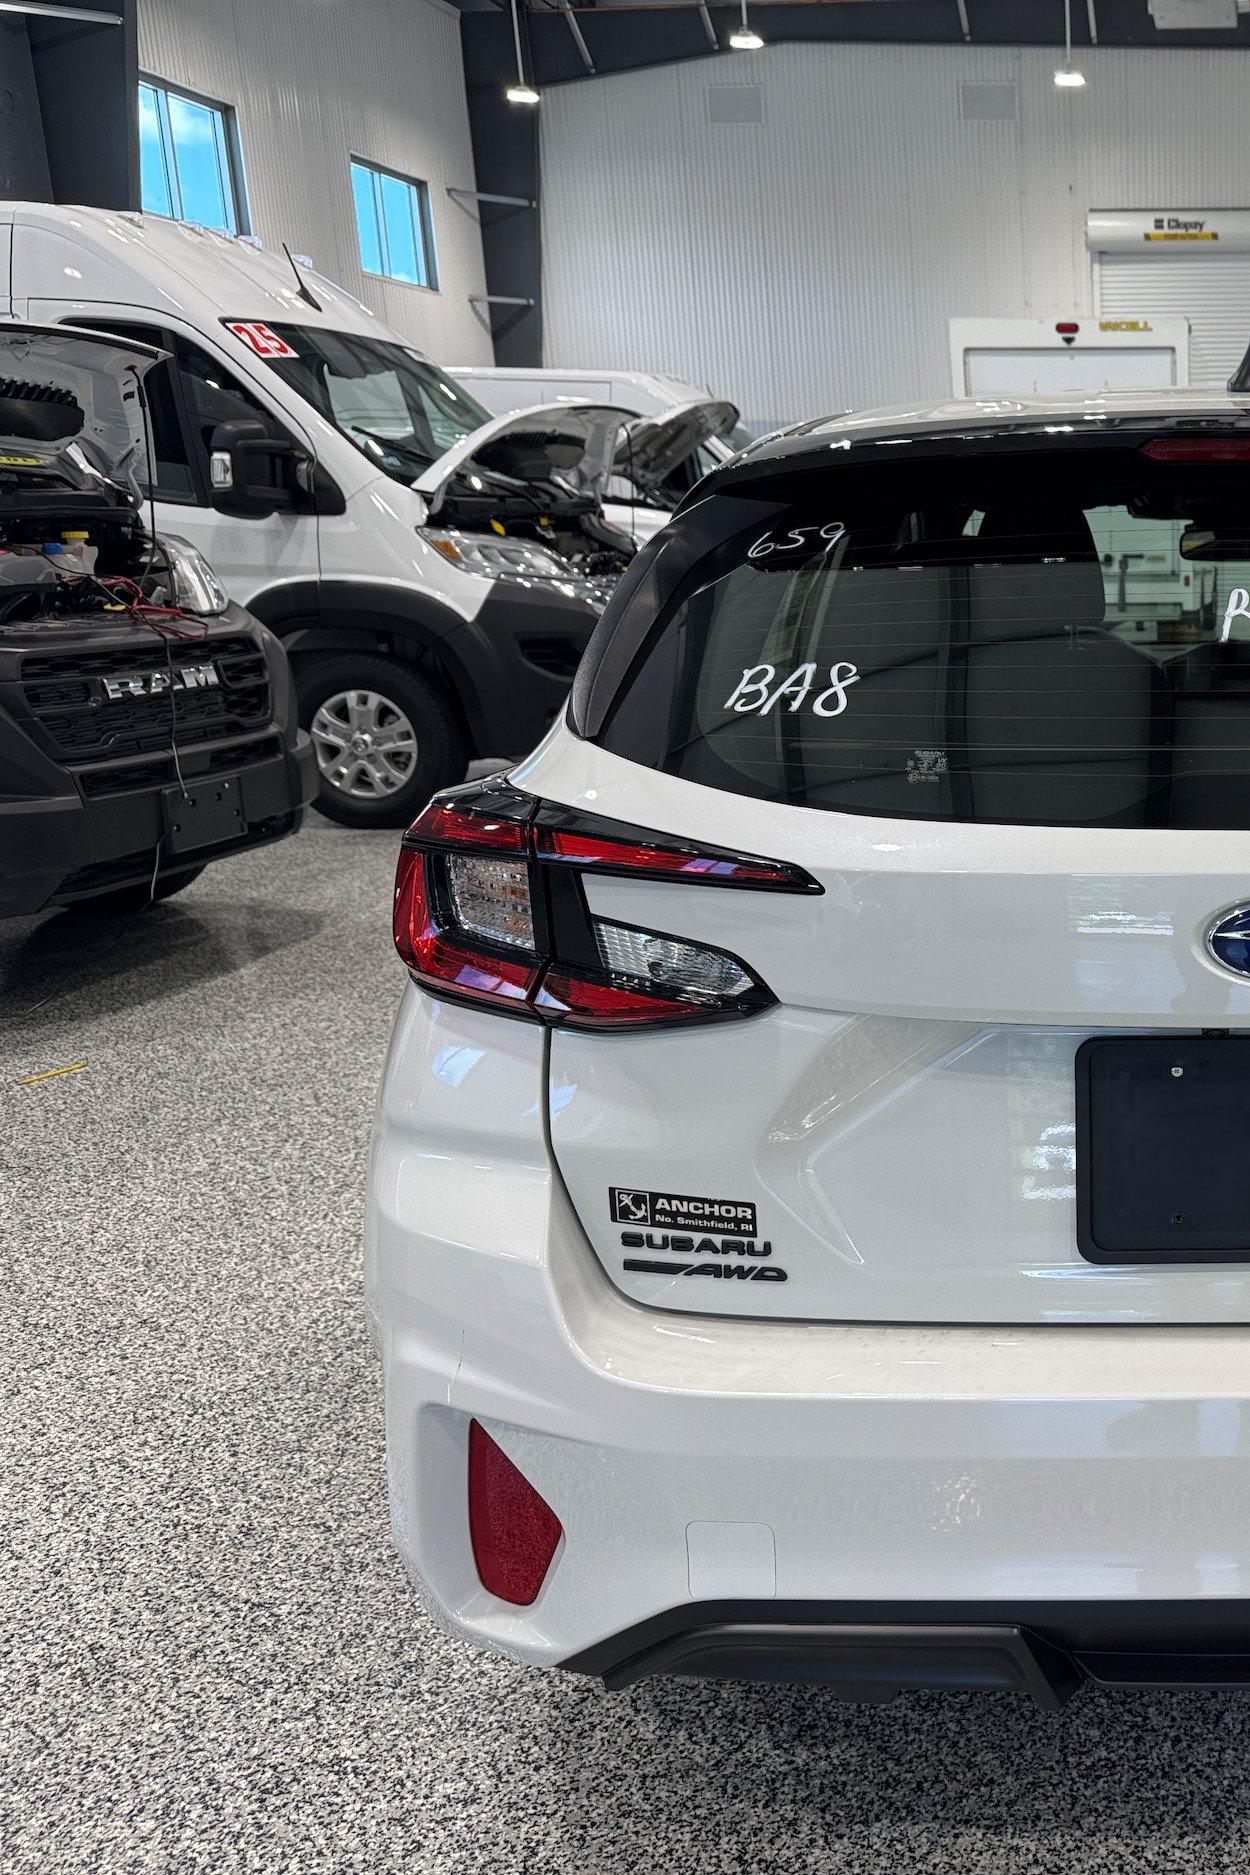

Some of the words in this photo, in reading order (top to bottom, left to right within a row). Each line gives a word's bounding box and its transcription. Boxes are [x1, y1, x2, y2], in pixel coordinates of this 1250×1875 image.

[232, 324, 289, 355] 25
[747, 521, 846, 558] 659
[102, 665, 220, 700] RAM
[722, 661, 861, 718] BA8
[655, 1198, 753, 1220] ANCHOR
[655, 1214, 675, 1224] No.
[676, 1216, 738, 1231] Smithfield,
[740, 1223, 753, 1232] RI
[620, 1231, 773, 1258] SUBARU
[682, 1263, 788, 1282] AWD
